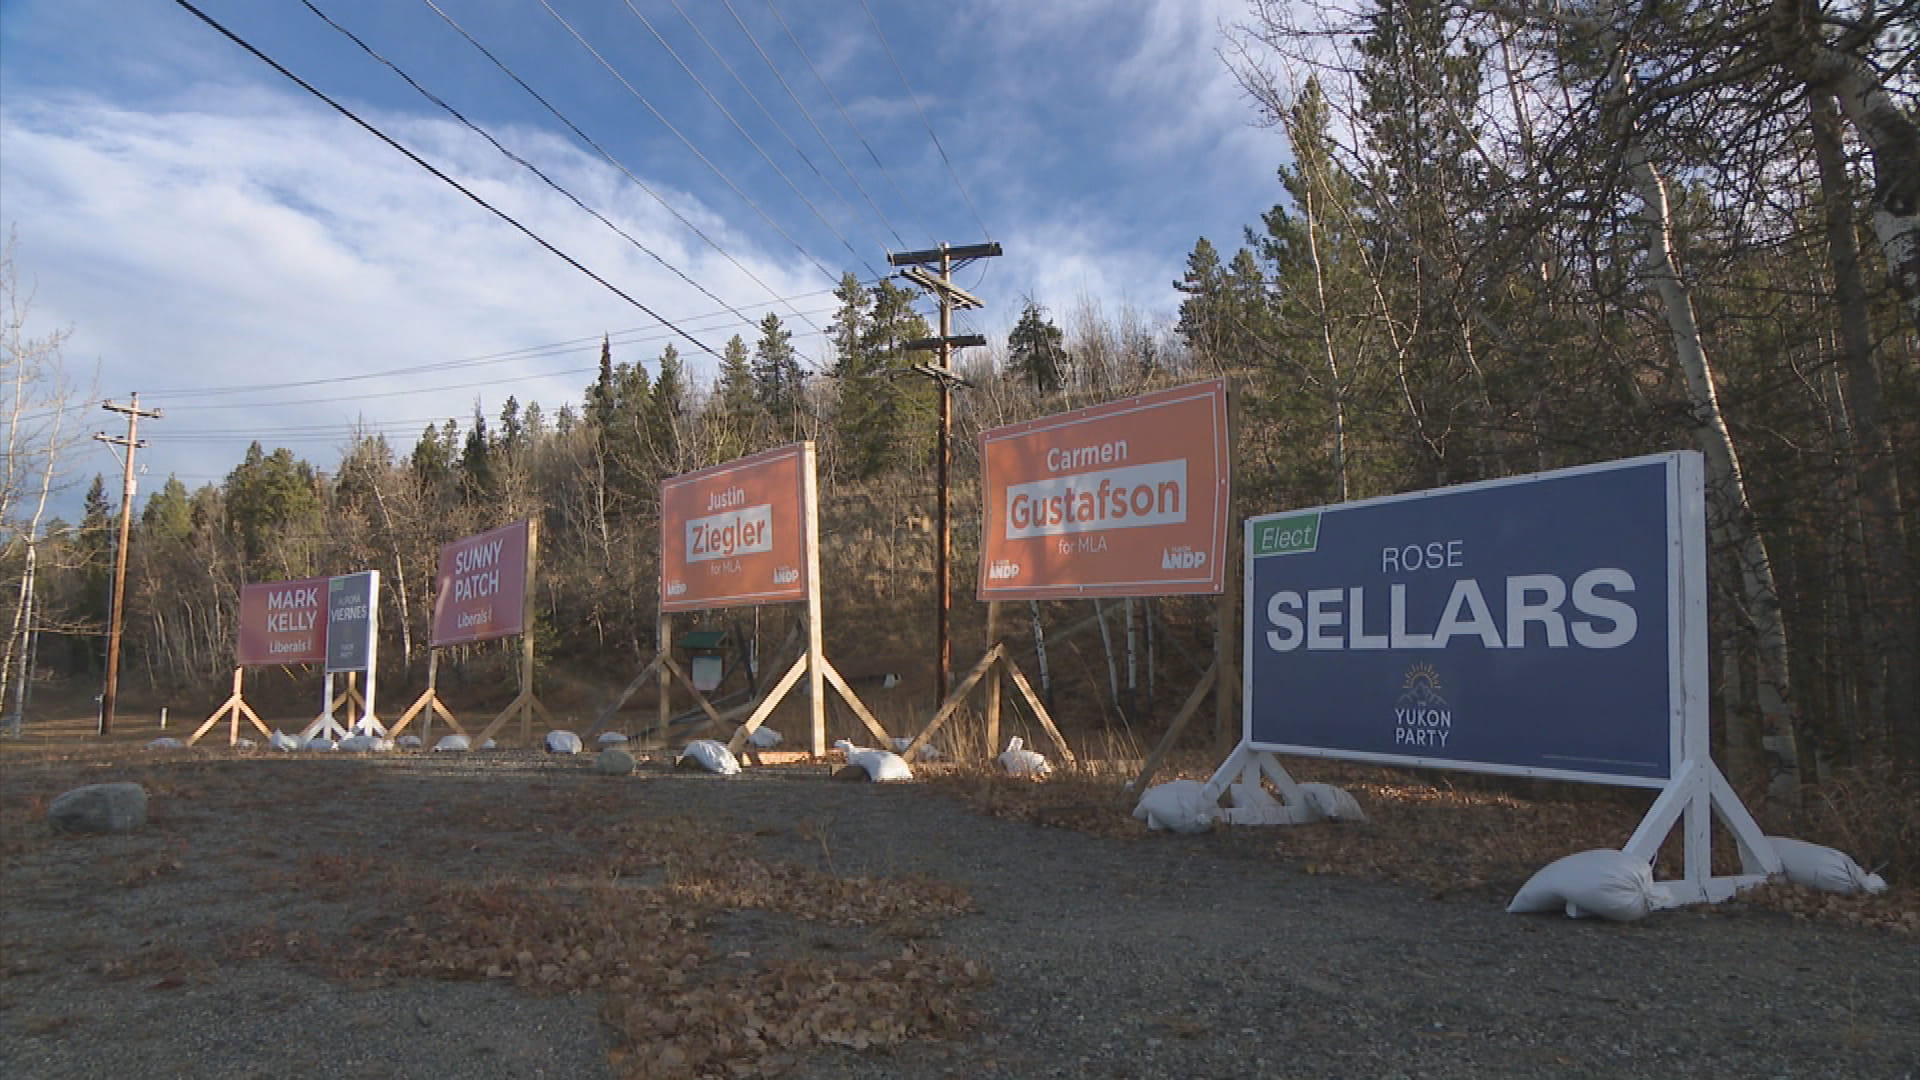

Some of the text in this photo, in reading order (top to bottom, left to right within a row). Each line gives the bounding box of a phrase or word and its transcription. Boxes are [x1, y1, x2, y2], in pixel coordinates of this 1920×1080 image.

[1047, 439, 1128, 472] Carmen
[707, 486, 745, 511] Justin
[1011, 478, 1180, 530] Gustafson
[692, 516, 765, 555] Ziegler
[1058, 536, 1108, 555] for MLA
[1260, 525, 1312, 551] Elect
[456, 539, 503, 575] SUNNY
[723, 560, 742, 575] MLA
[1382, 540, 1464, 573] ROSE
[456, 569, 499, 603] PATCH
[268, 588, 319, 610] MARK
[1266, 567, 1638, 652] SELLARS
[267, 611, 318, 633] KELLY
[457, 608, 488, 628] Liberals
[269, 640, 306, 654] Liberals
[1394, 708, 1451, 728] YUKON
[1395, 728, 1449, 748] PARTY
